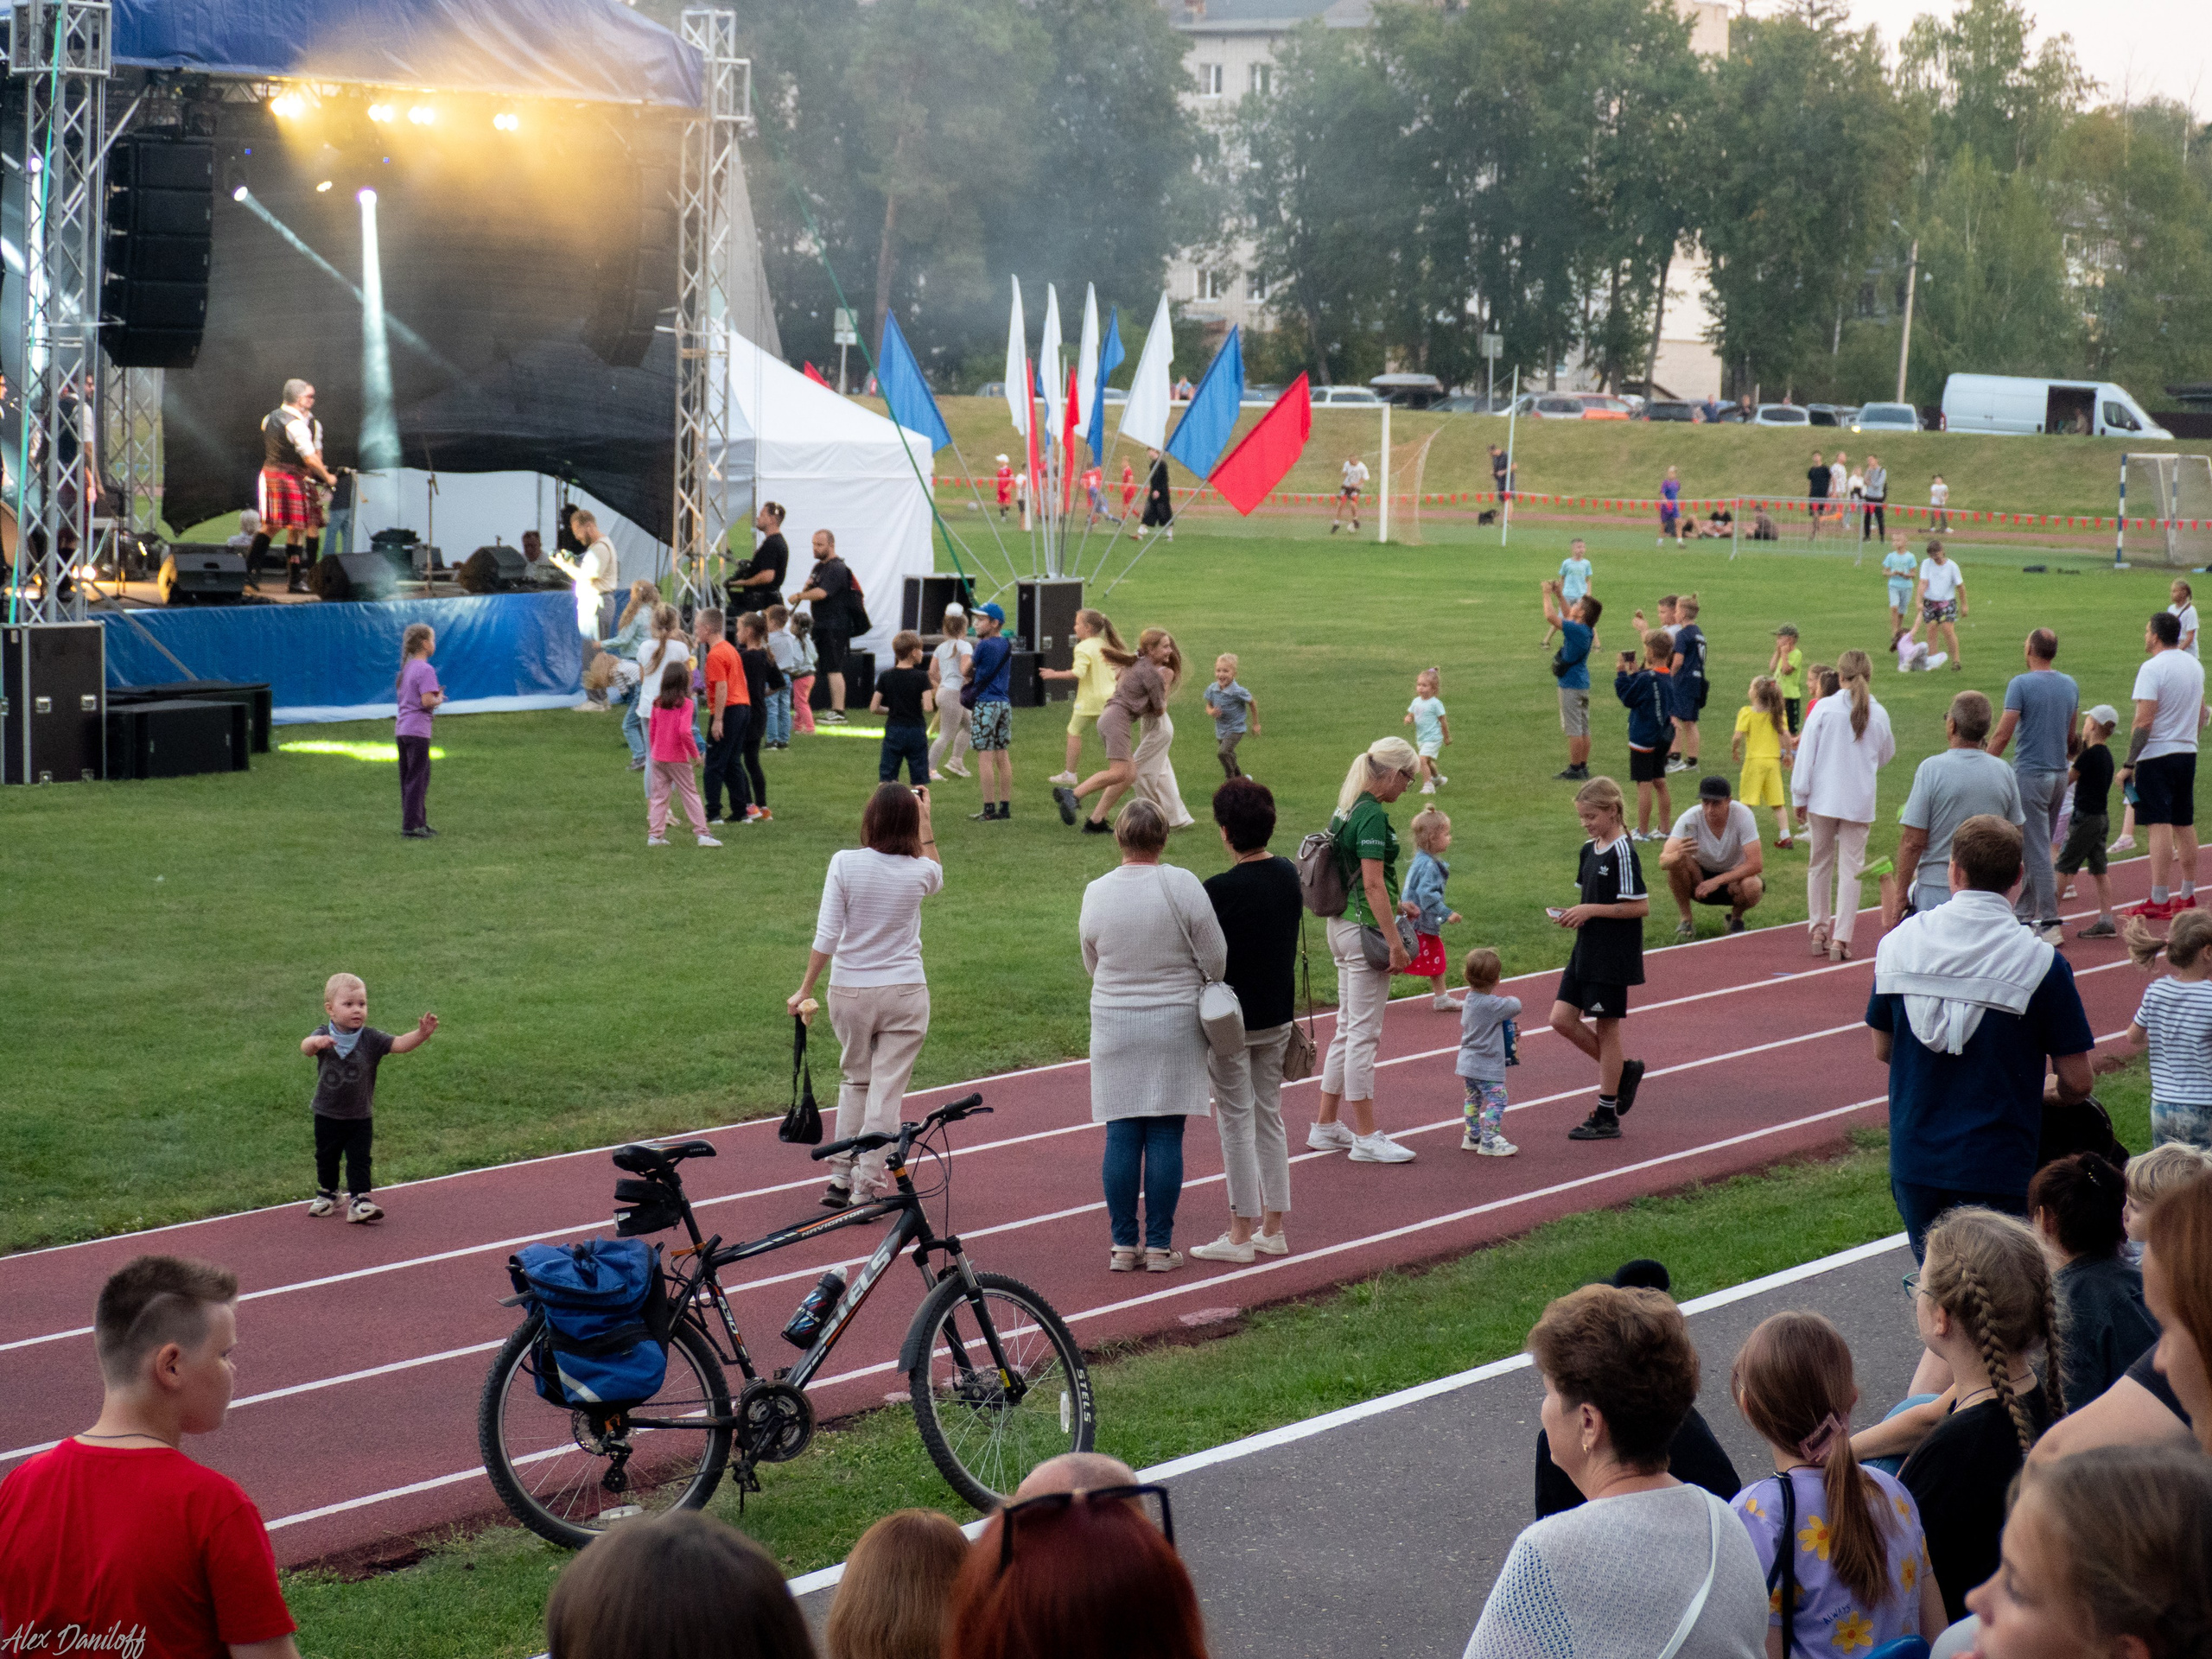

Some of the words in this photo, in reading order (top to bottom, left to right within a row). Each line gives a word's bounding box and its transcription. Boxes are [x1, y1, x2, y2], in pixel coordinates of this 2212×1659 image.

[801, 1208, 865, 1237] NAVIGATOR
[819, 1245, 891, 1344] STELS
[1077, 1369, 1091, 1423] STELS
